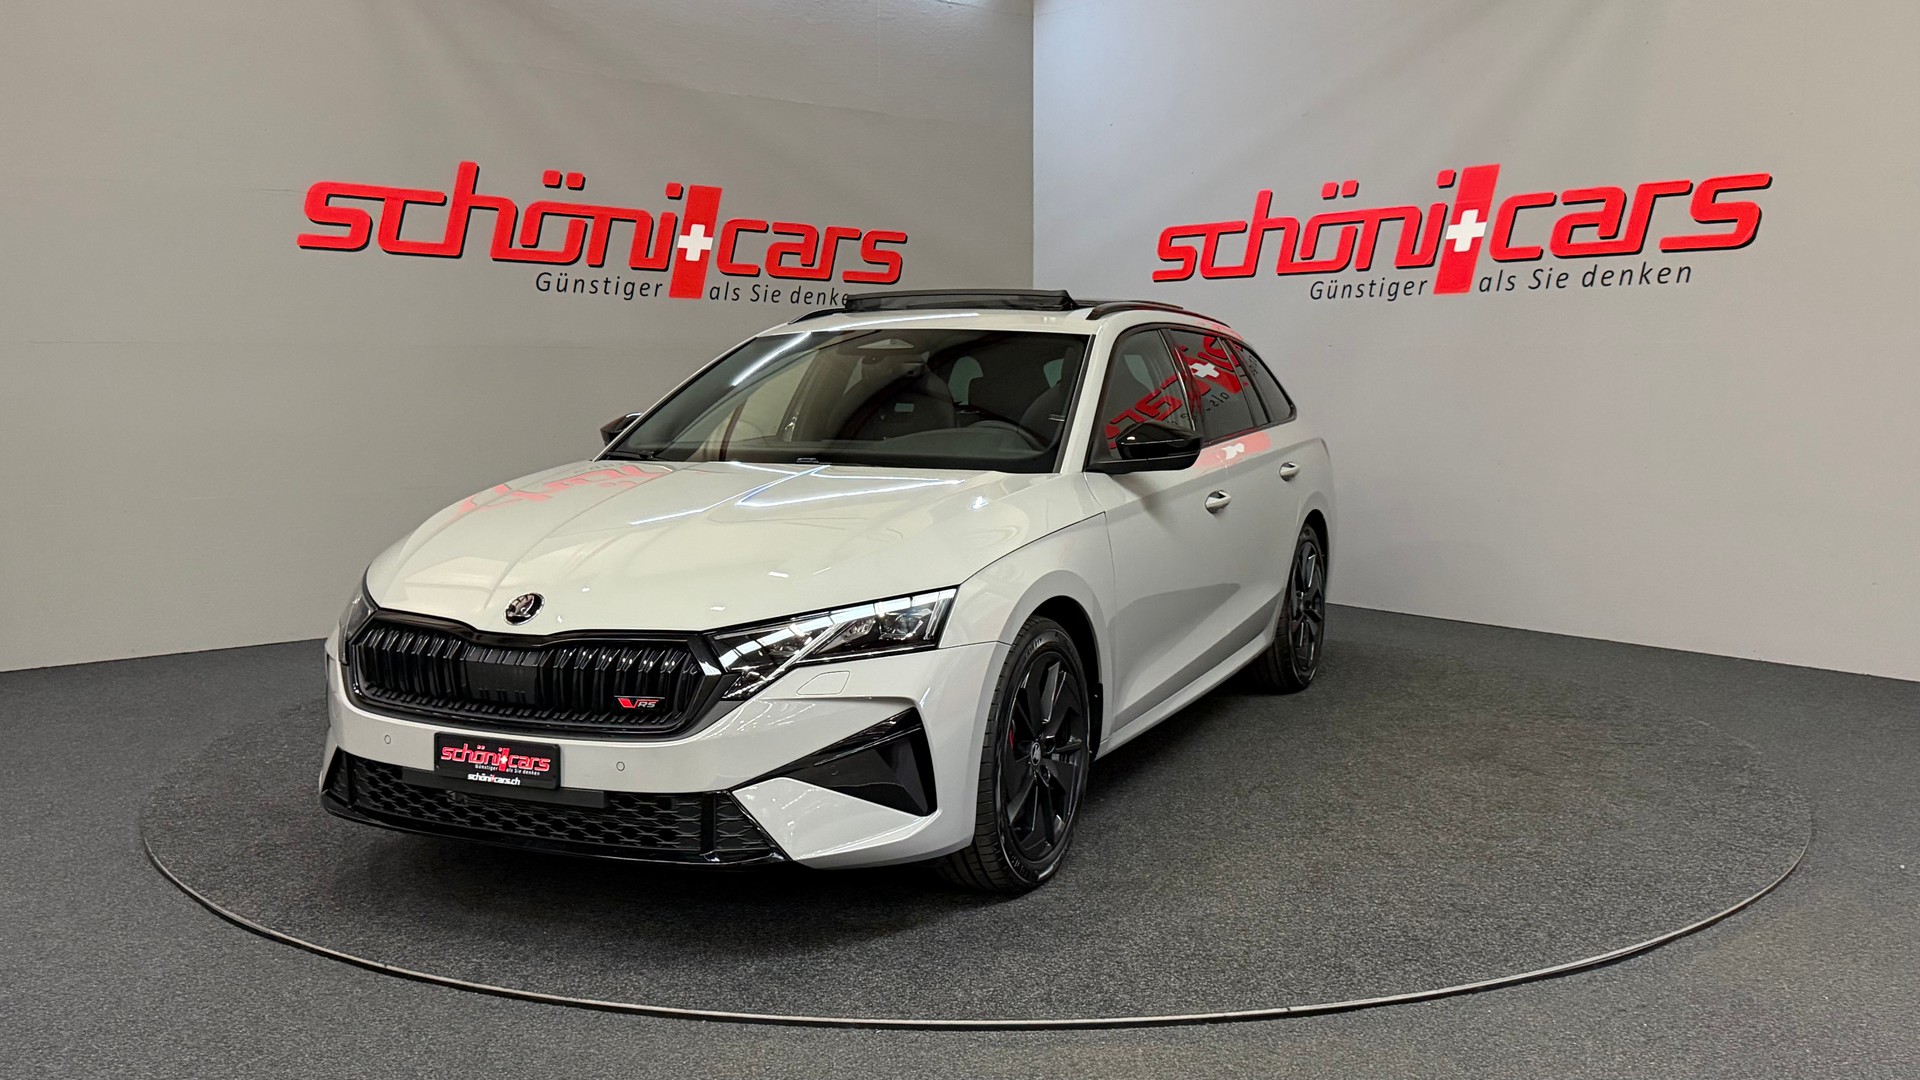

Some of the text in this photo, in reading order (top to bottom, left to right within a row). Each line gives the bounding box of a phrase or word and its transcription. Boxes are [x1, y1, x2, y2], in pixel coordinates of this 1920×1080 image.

[535, 271, 850, 307] Günstiger als Sie denke
[1310, 261, 1693, 302] Günstiger als Sie denken
